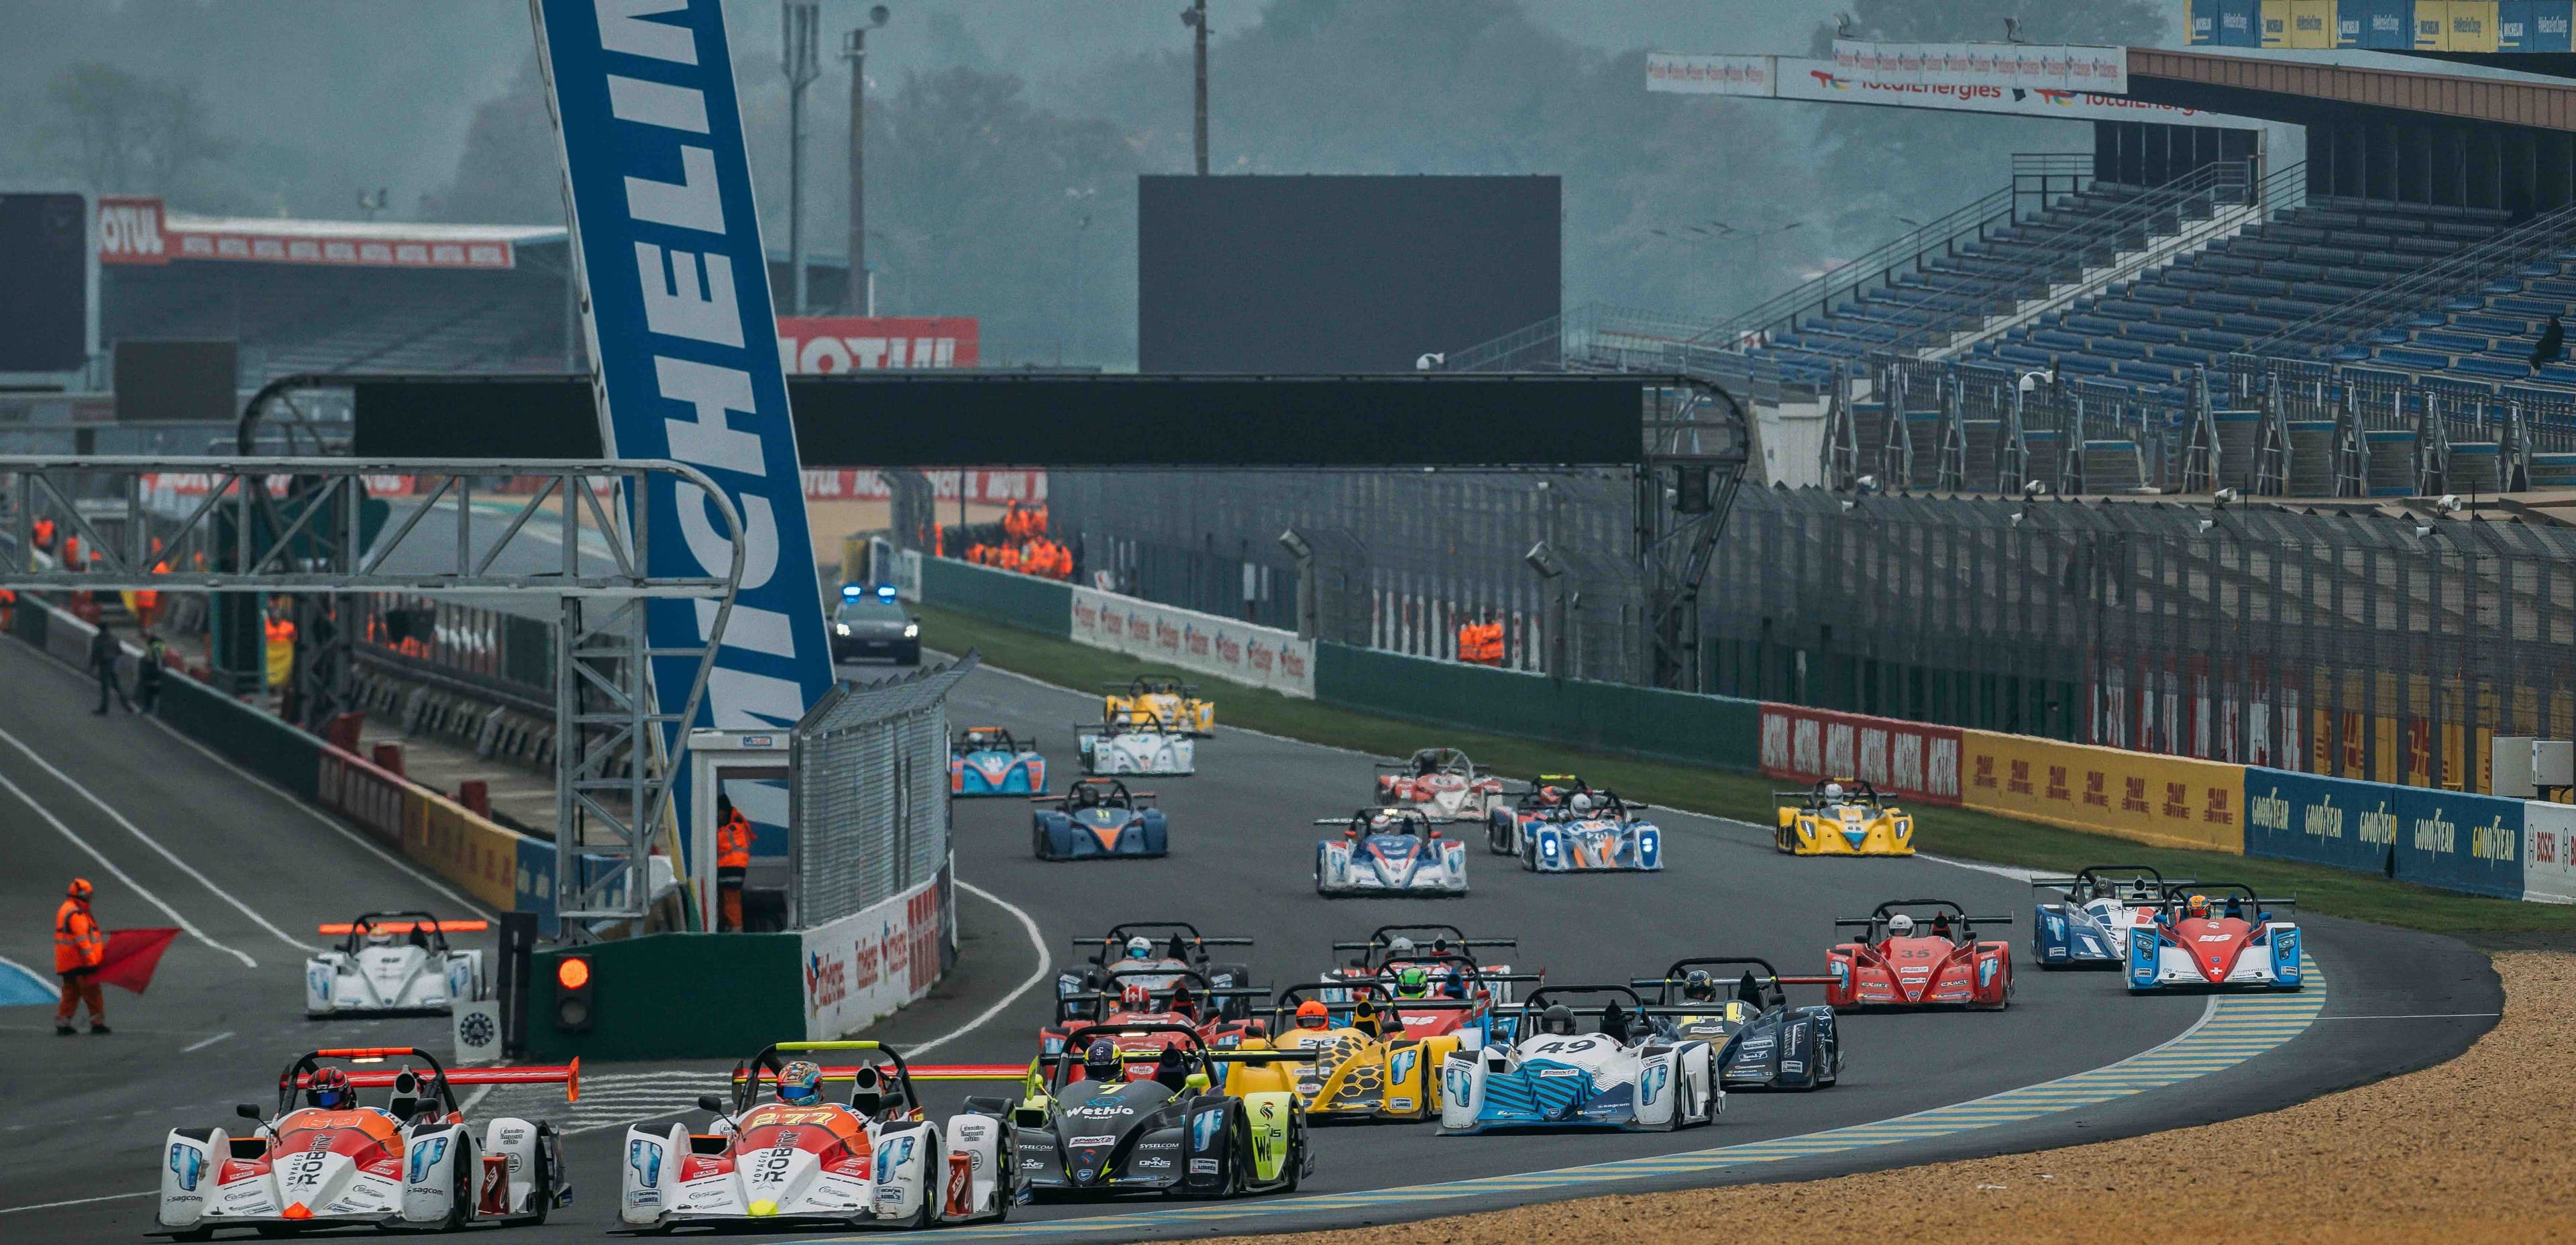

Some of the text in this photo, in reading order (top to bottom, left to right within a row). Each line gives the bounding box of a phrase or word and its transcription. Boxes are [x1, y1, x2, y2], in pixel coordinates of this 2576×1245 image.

[98, 207, 164, 255] OTUL
[2251, 792, 2290, 833] GOODYEAR
[2305, 800, 2343, 841] GOODYEAR
[2359, 807, 2398, 847] GOODYEAR
[2414, 814, 2455, 856] GOODYEAR
[2472, 822, 2516, 863] GOODYEAR
[2536, 831, 2555, 863] BOSCH
[1900, 949, 1930, 959] 35
[1300, 1038, 1336, 1046] 26
[1534, 1039, 1597, 1054] 49
[1099, 1084, 1128, 1095] 7
[750, 1112, 837, 1128] 277
[1066, 1105, 1134, 1118] Wethio
[286, 1154, 304, 1187] VOYAGES
[752, 1151, 769, 1184] VOYAGES
[172, 1195, 203, 1203] sagcom
[413, 1187, 443, 1196] sagcom
